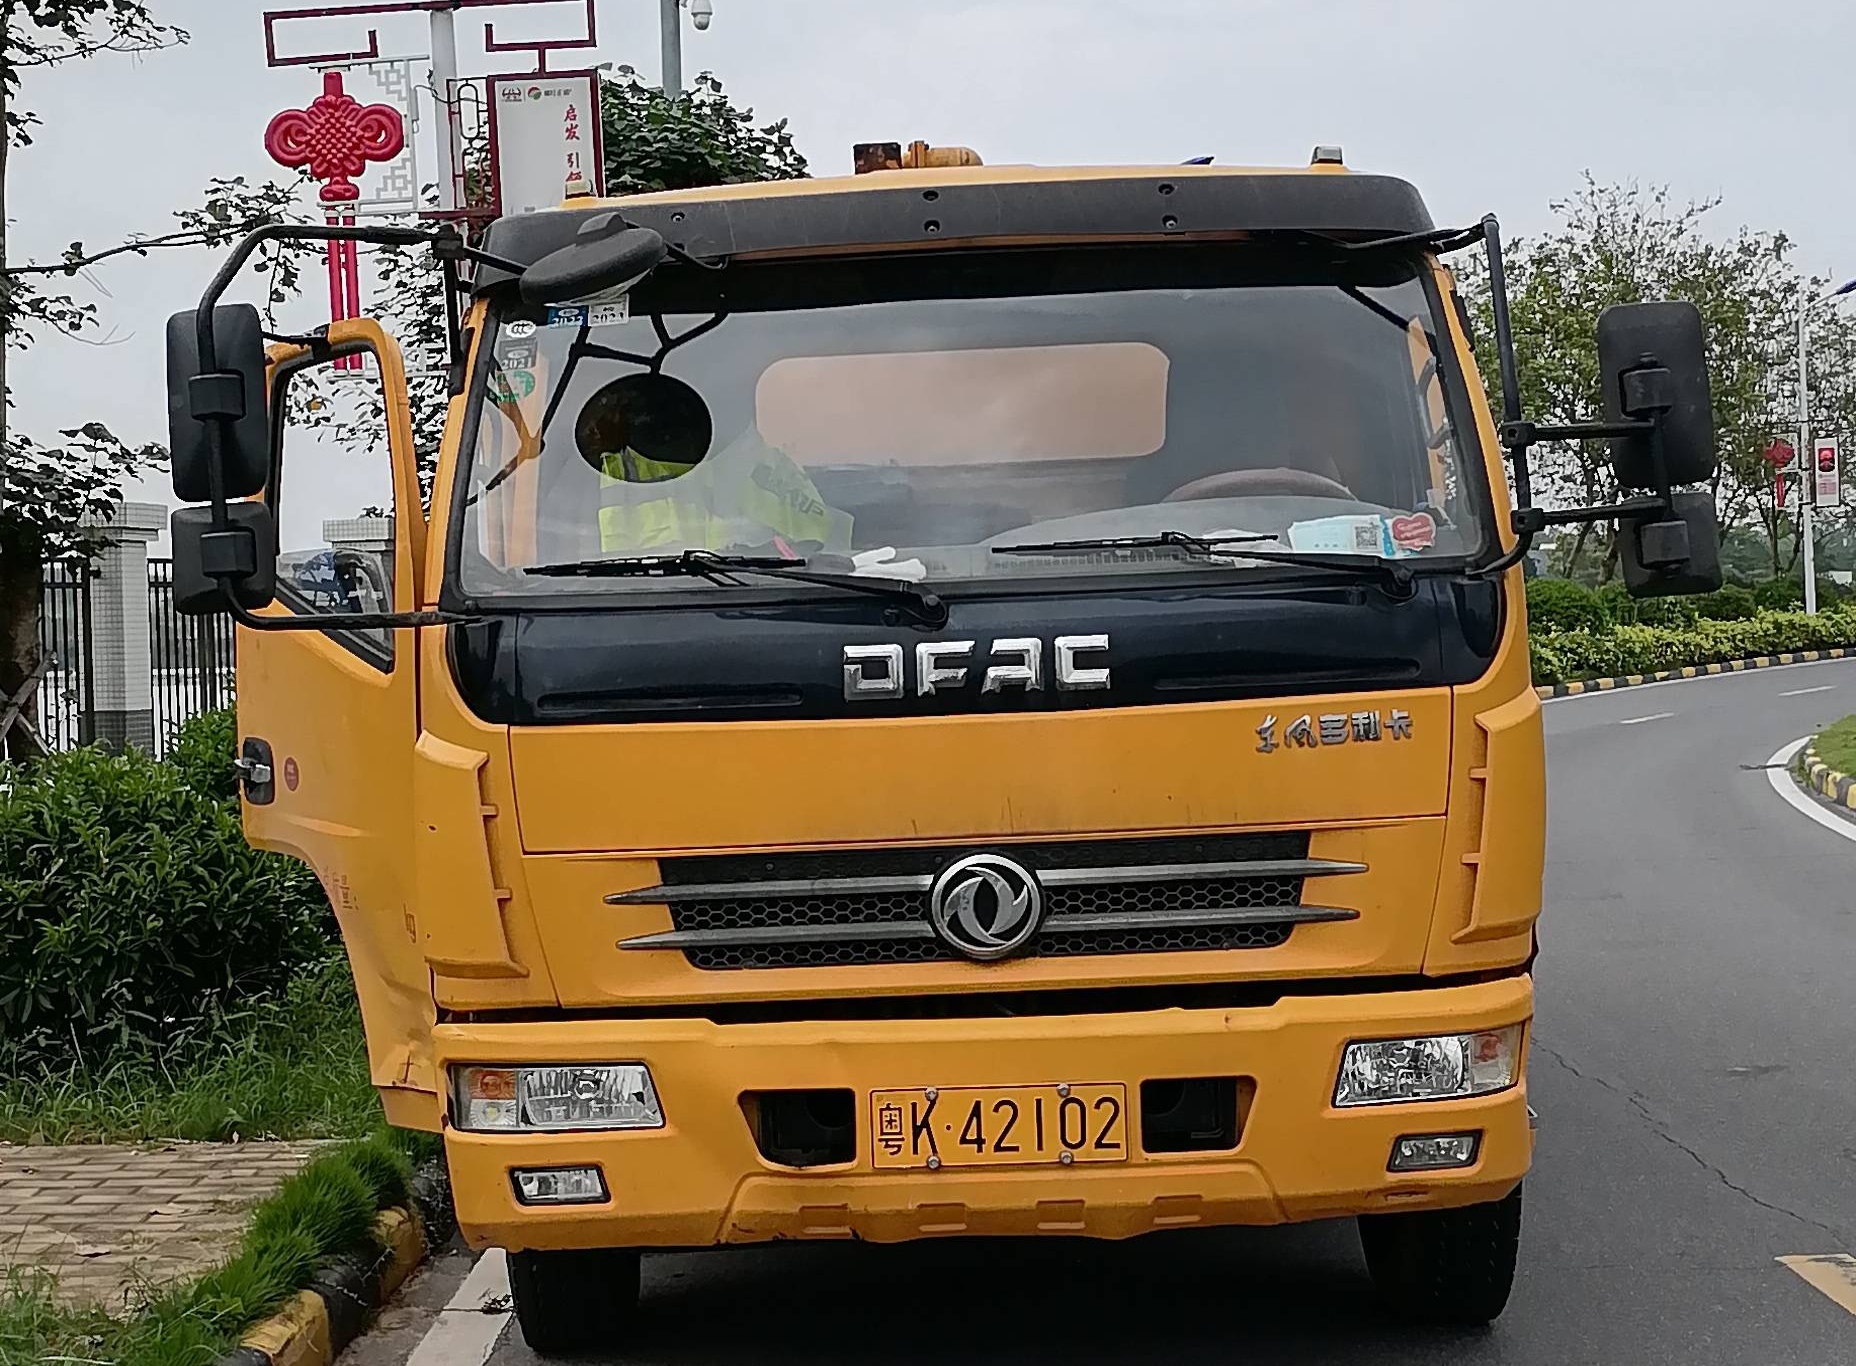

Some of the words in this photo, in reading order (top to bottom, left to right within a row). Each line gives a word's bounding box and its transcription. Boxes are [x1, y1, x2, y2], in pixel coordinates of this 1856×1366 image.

[843, 634, 1111, 702] DFAC
[1255, 708, 1414, 753] 东风多利卡
